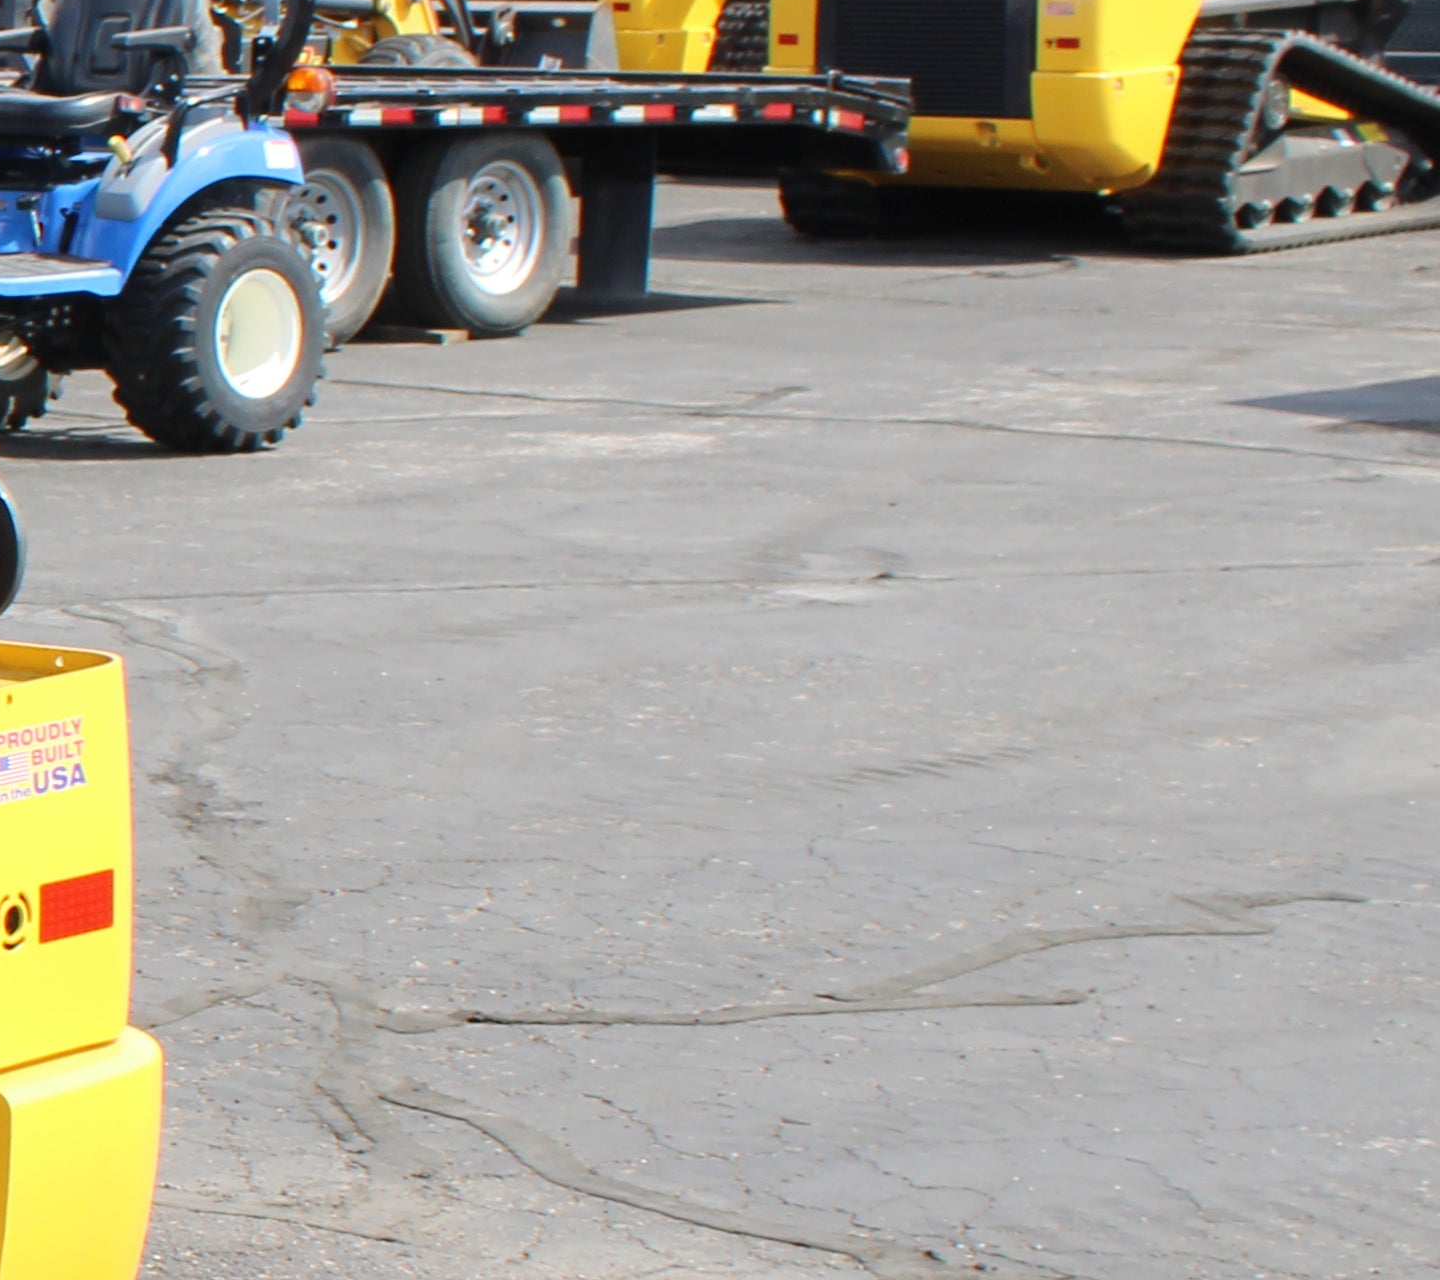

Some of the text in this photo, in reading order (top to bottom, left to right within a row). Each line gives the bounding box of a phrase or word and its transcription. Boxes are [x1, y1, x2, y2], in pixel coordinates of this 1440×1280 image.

[31, 740, 85, 766] BUILT
[11, 784, 31, 800] the
[33, 762, 87, 794] USA
